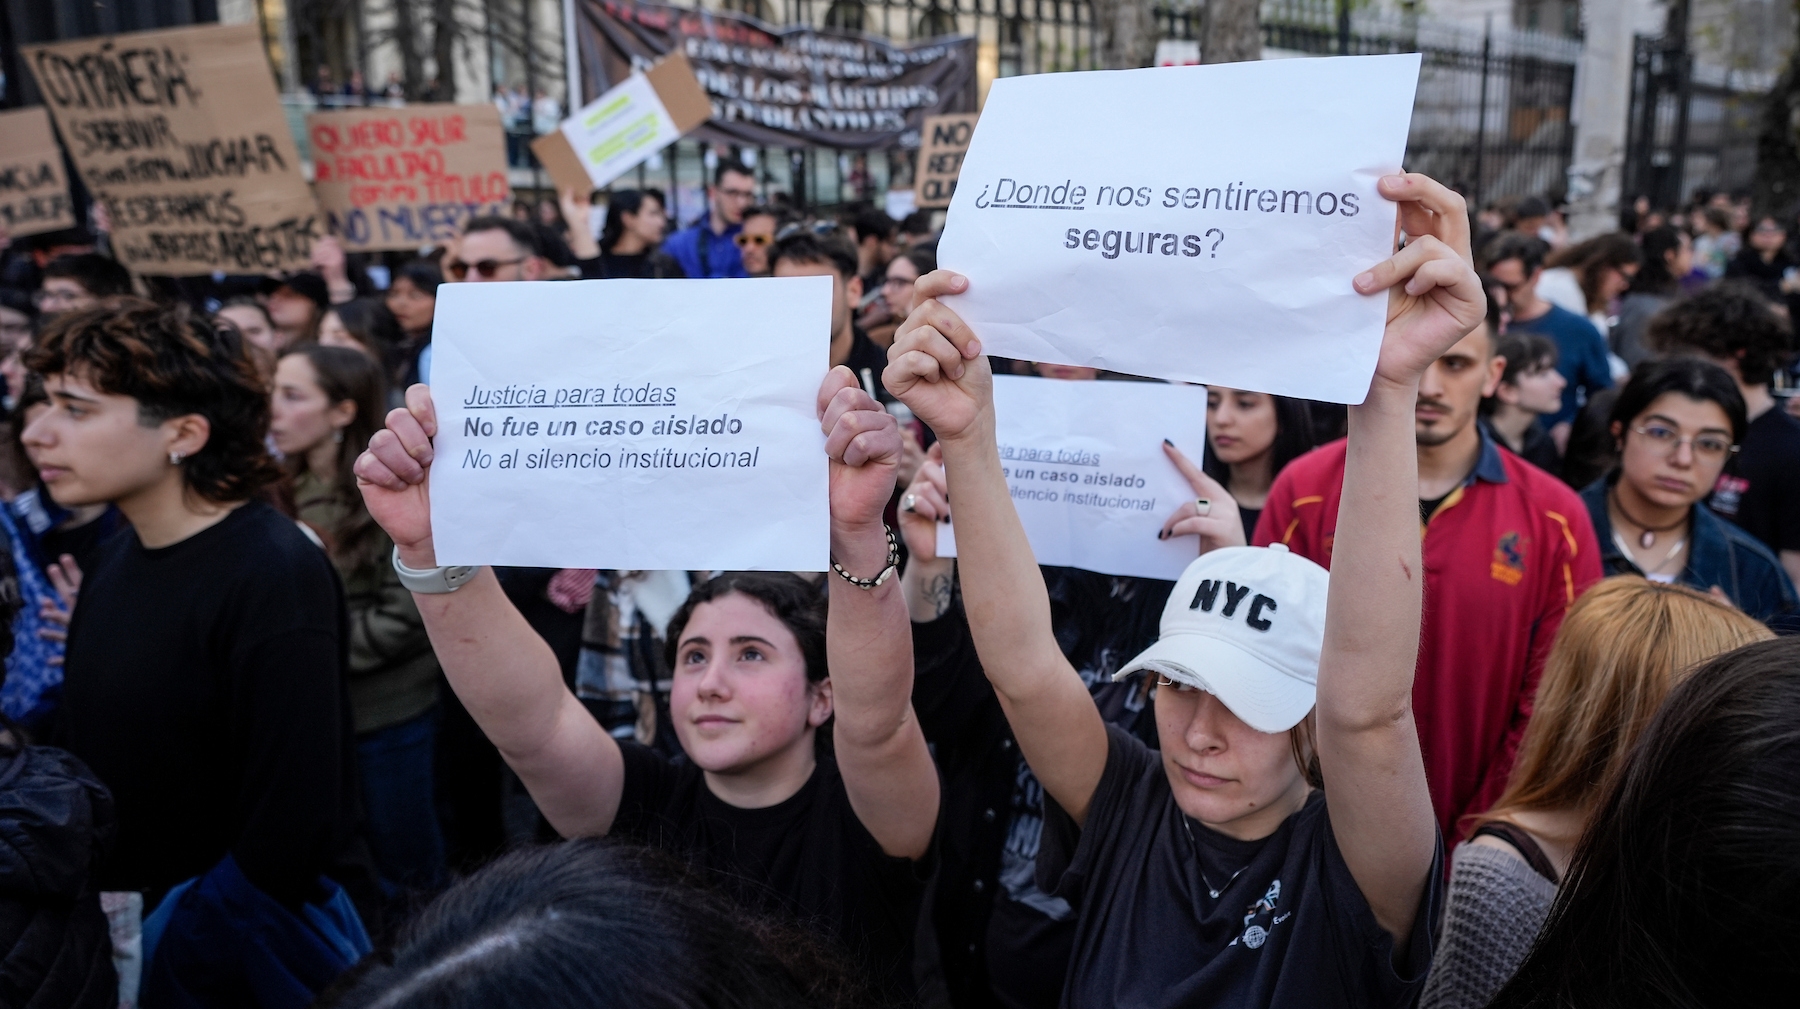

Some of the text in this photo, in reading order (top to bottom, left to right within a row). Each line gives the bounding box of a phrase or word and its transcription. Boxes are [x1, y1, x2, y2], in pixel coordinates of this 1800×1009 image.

[932, 121, 971, 147] NO
[975, 178, 1361, 217] ¿Donde nos sentiremos
[1063, 226, 1225, 260] seguras?
[464, 383, 677, 409] Justicia para todas
[463, 414, 743, 437] No fue un caso aislado
[462, 446, 760, 469] No al silencio institucional
[1018, 447, 1053, 463] para
[1057, 448, 1101, 466] todas
[1014, 467, 1035, 480] un
[1039, 470, 1079, 484] caso
[1083, 472, 1146, 489] aislado
[1010, 485, 1157, 512] ilencio institucional
[1188, 578, 1278, 632] NYC
